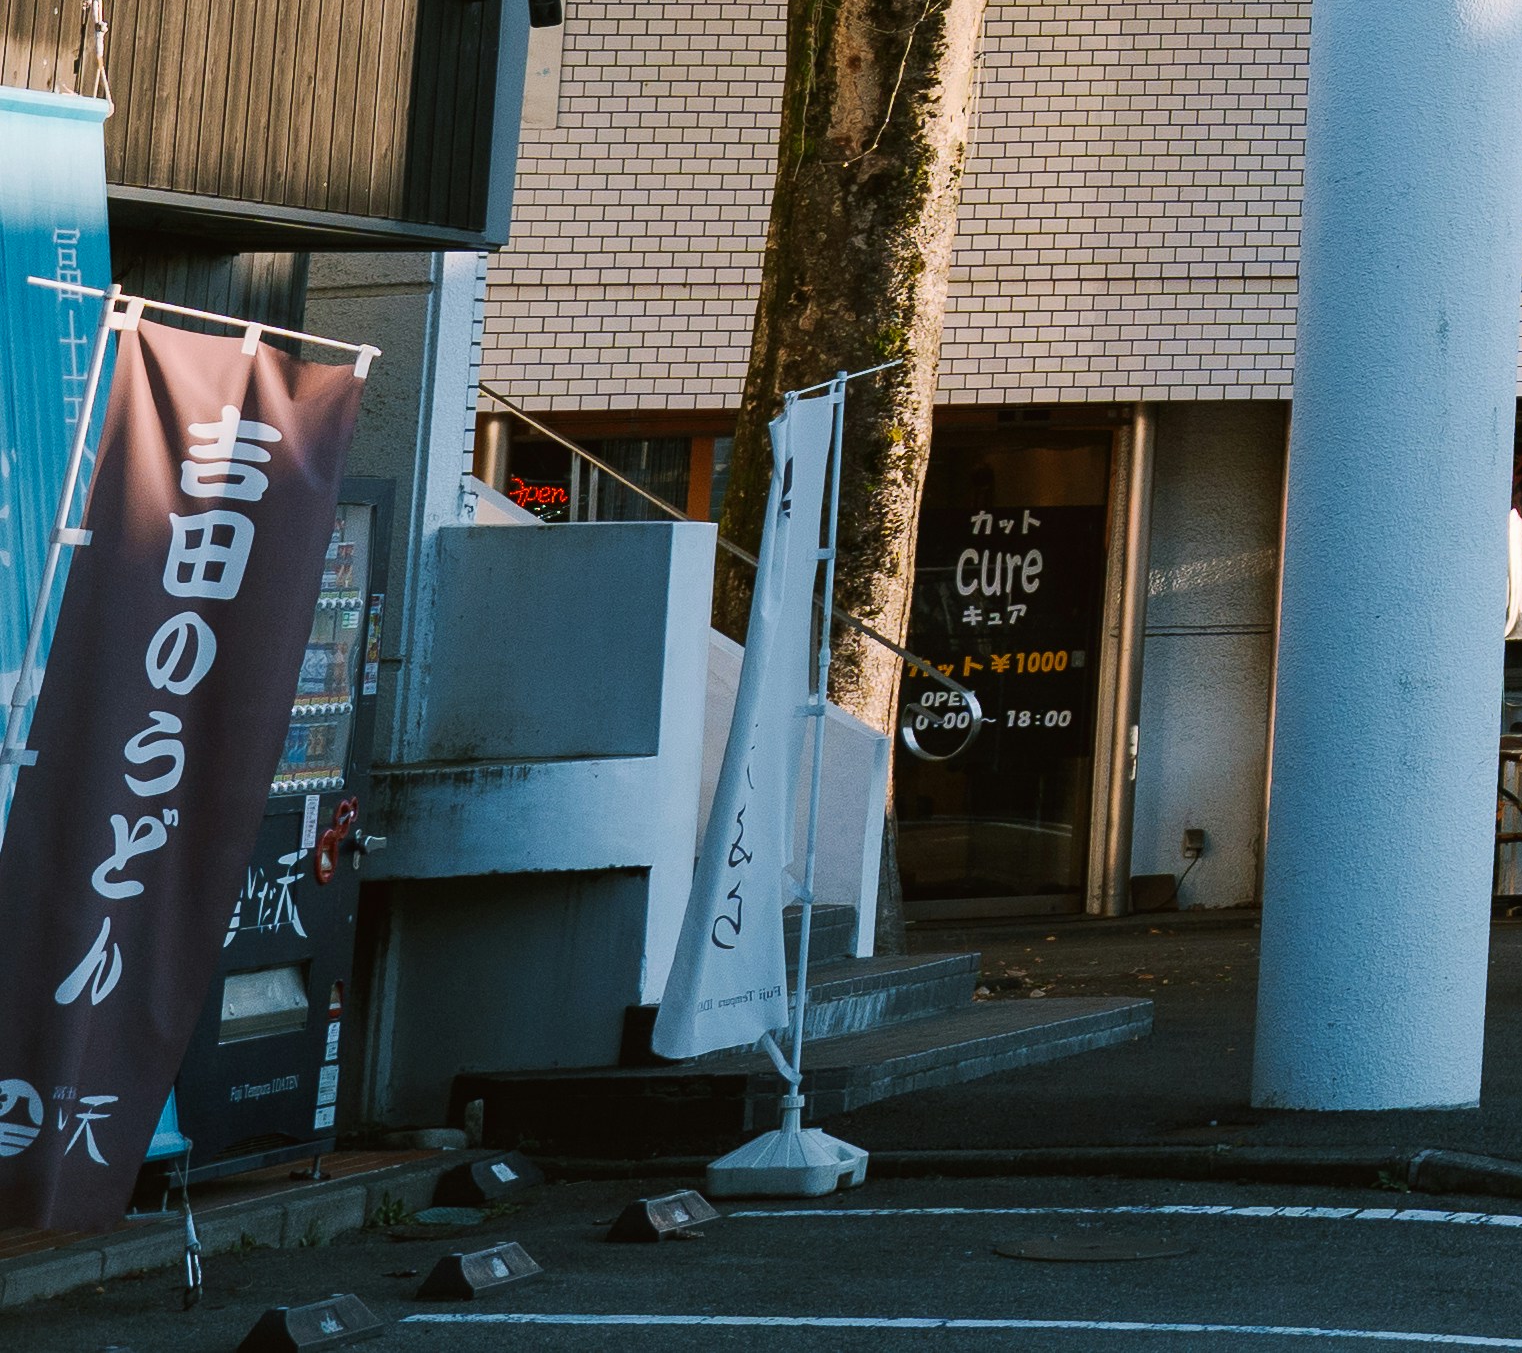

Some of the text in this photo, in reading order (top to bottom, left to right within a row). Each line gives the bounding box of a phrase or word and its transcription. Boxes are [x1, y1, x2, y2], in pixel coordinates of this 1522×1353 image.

[971, 510, 1041, 534] カット
[962, 604, 1027, 625] キュア
[55, 405, 283, 1006] 吉田のうどん
[921, 692, 974, 707] OPE
[1006, 710, 1072, 728] 18:00
